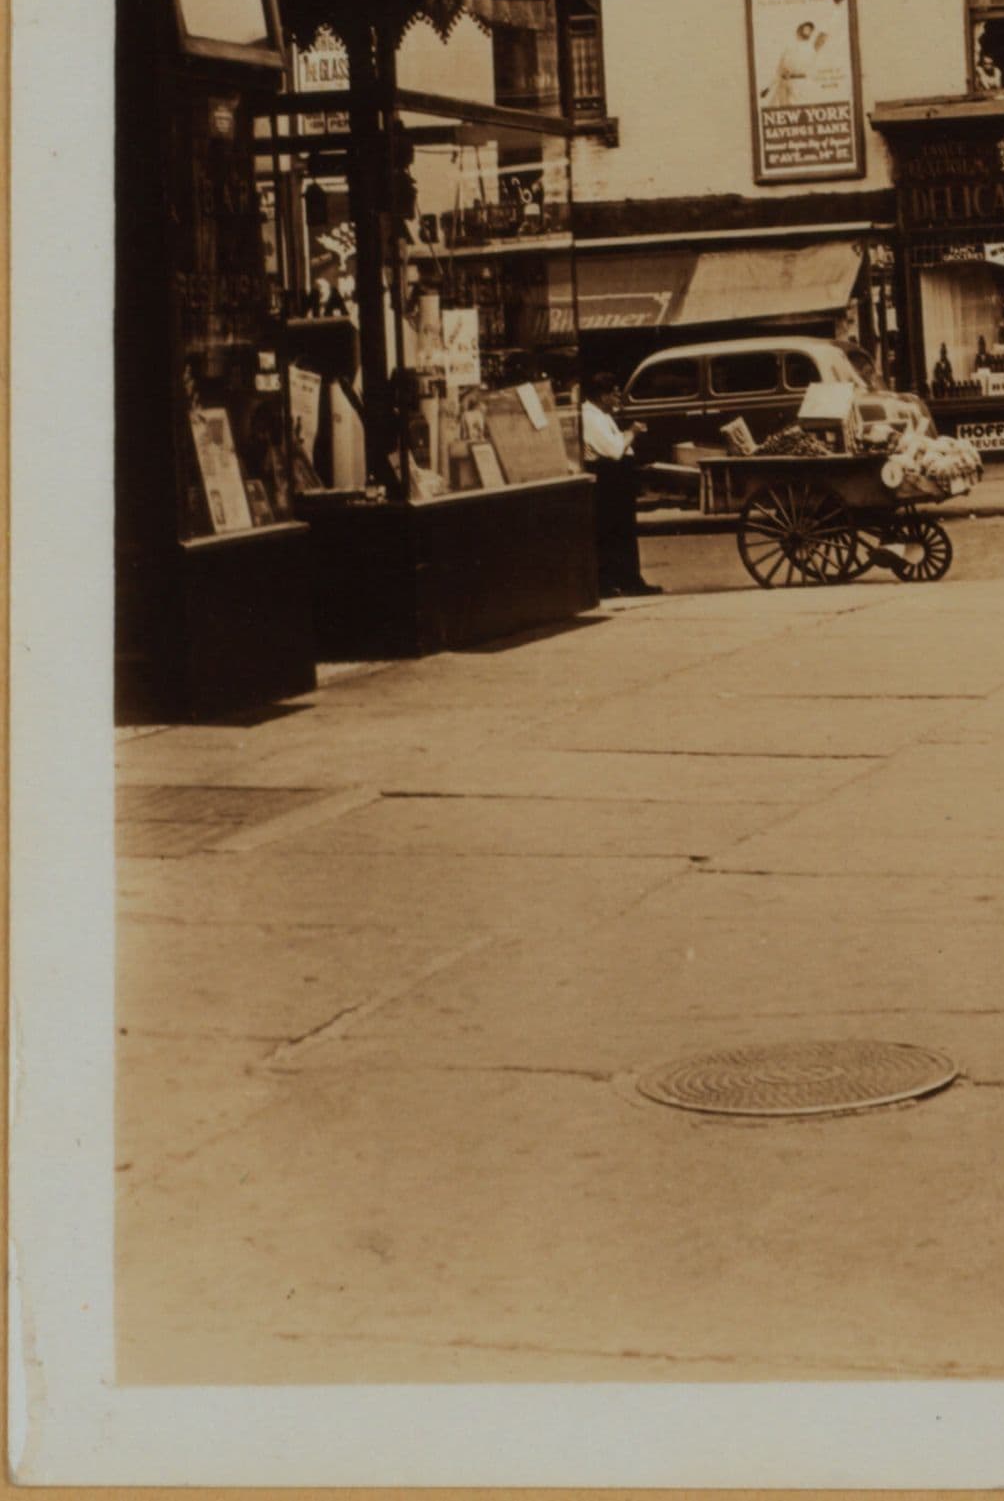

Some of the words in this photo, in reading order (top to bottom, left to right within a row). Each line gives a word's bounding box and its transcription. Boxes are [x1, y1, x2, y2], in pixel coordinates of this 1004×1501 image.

[763, 108, 800, 126] NEW
[804, 105, 850, 123] YORK
[766, 126, 814, 140] SAVINGS
[816, 122, 849, 136] BANK
